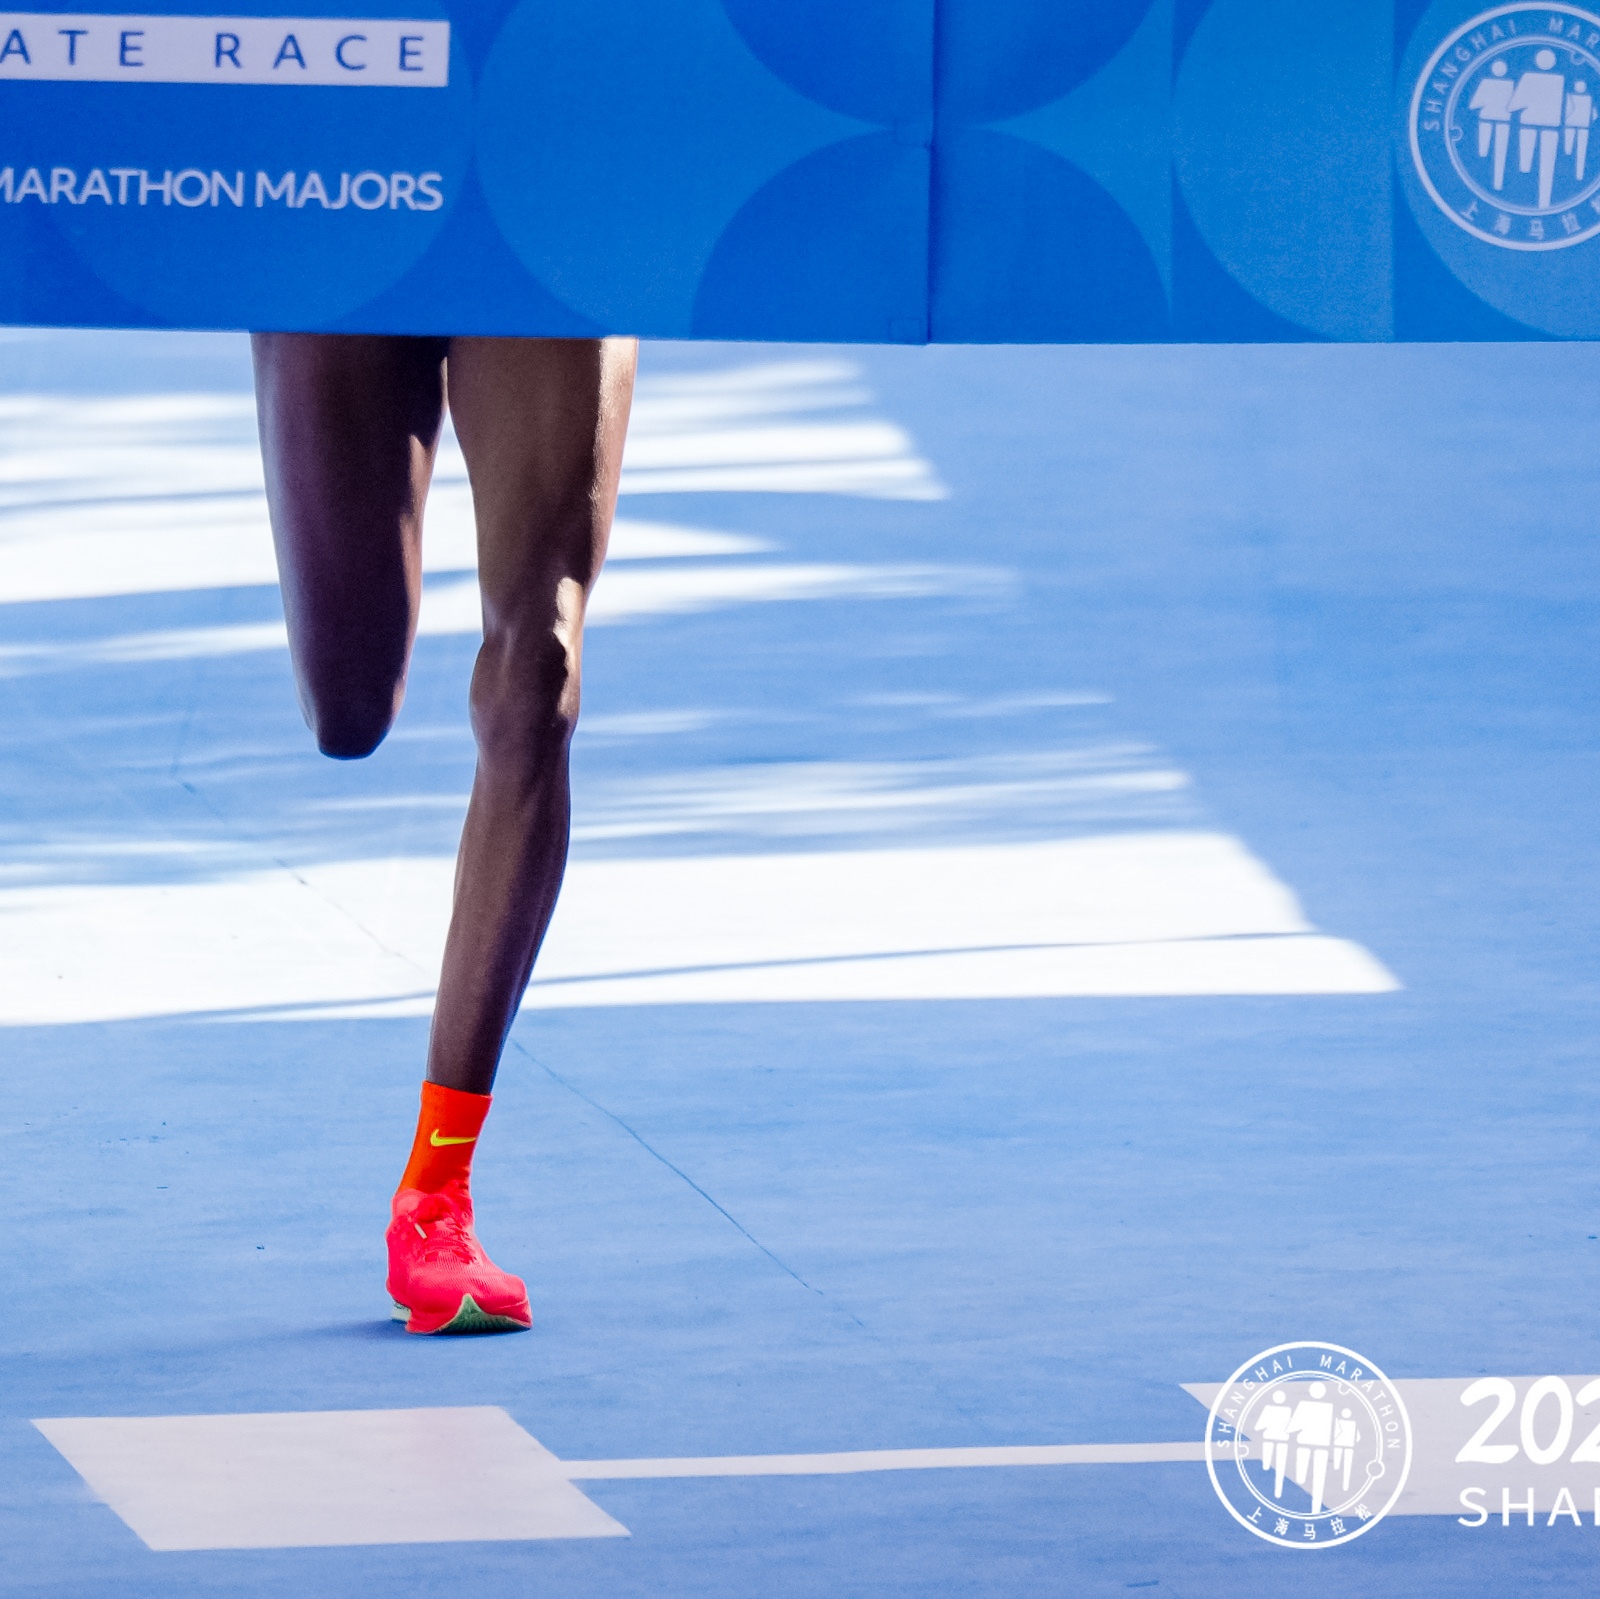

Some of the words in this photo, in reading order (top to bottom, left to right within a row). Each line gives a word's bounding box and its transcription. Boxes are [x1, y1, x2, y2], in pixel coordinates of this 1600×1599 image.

[215, 32, 425, 72] RACE
[1423, 19, 1517, 132] SHANGHAI
[255, 171, 444, 212] MAJORS
